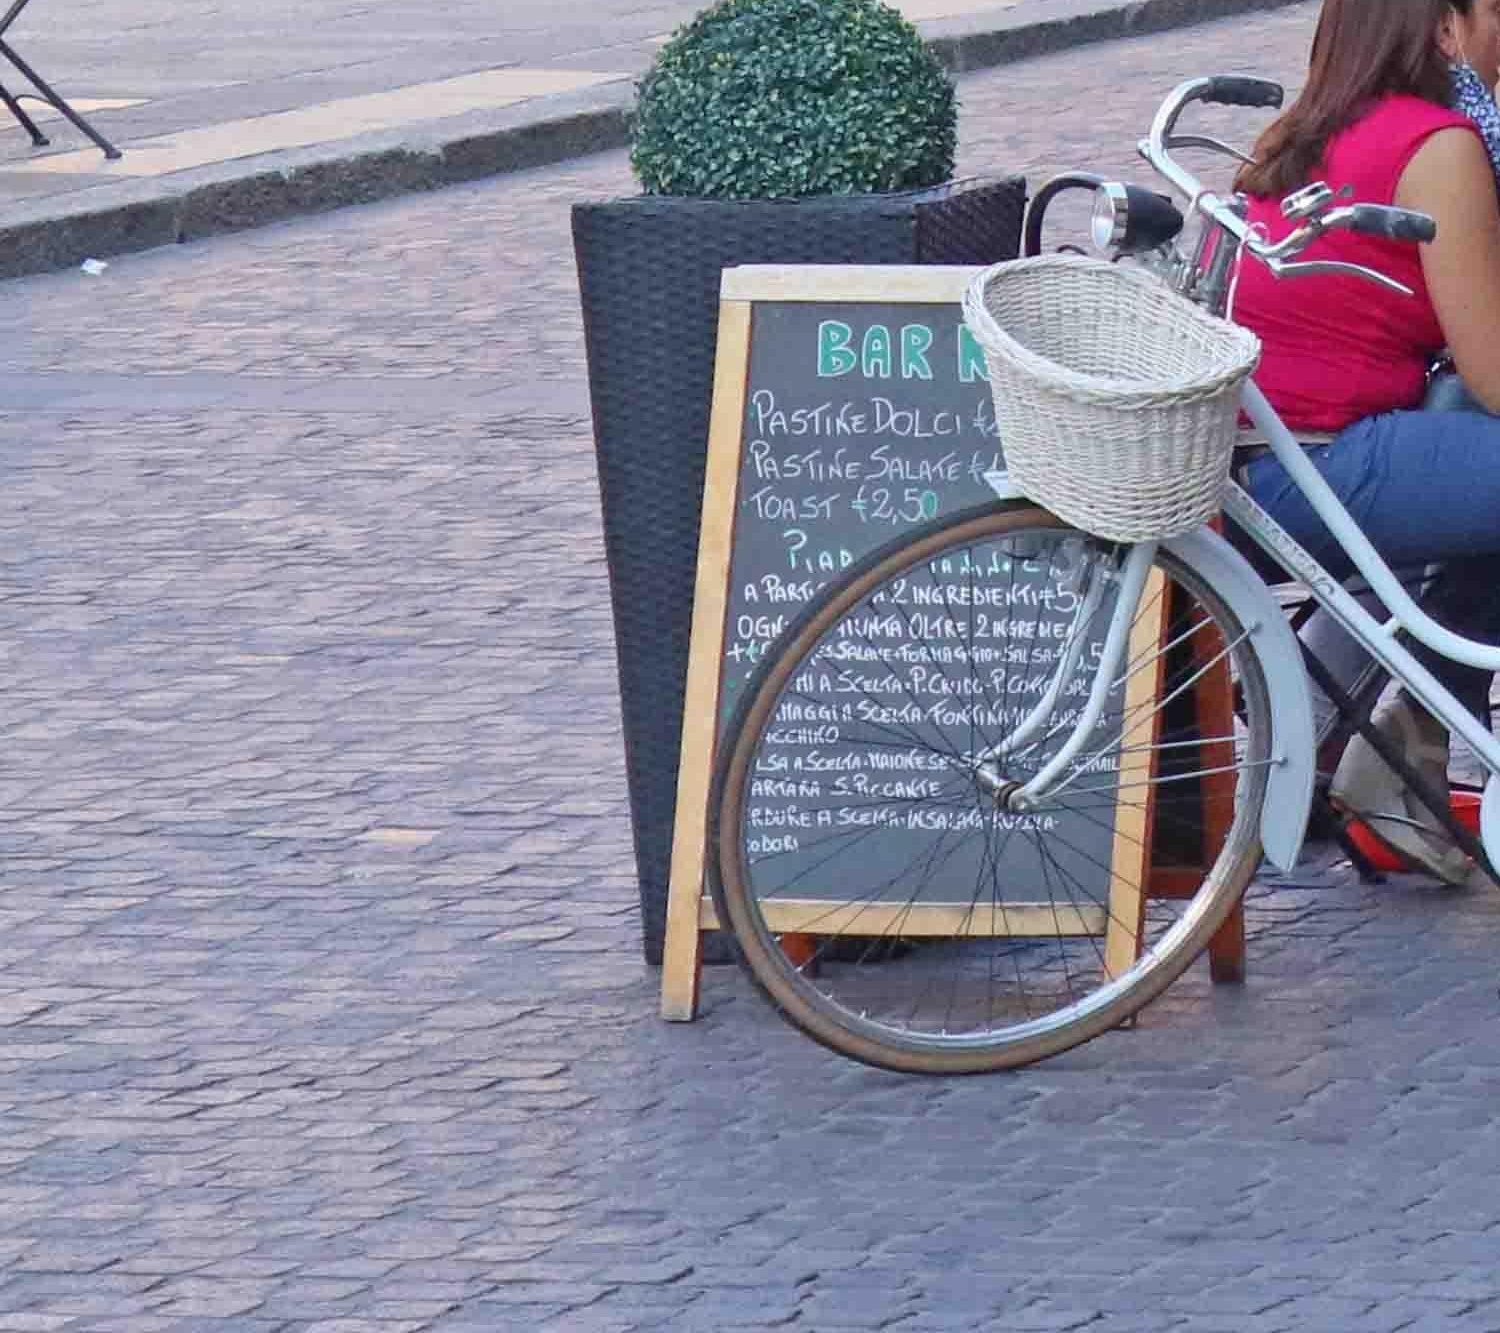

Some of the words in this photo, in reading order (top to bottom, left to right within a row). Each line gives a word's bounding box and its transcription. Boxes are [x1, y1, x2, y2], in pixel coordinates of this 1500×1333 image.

[817, 319, 934, 379] BAR
[752, 389, 867, 435] PASTINE
[872, 397, 961, 437] DOLCI
[750, 439, 861, 481] PASTINE
[864, 444, 963, 482] SALATE
[750, 485, 841, 521] TOAST
